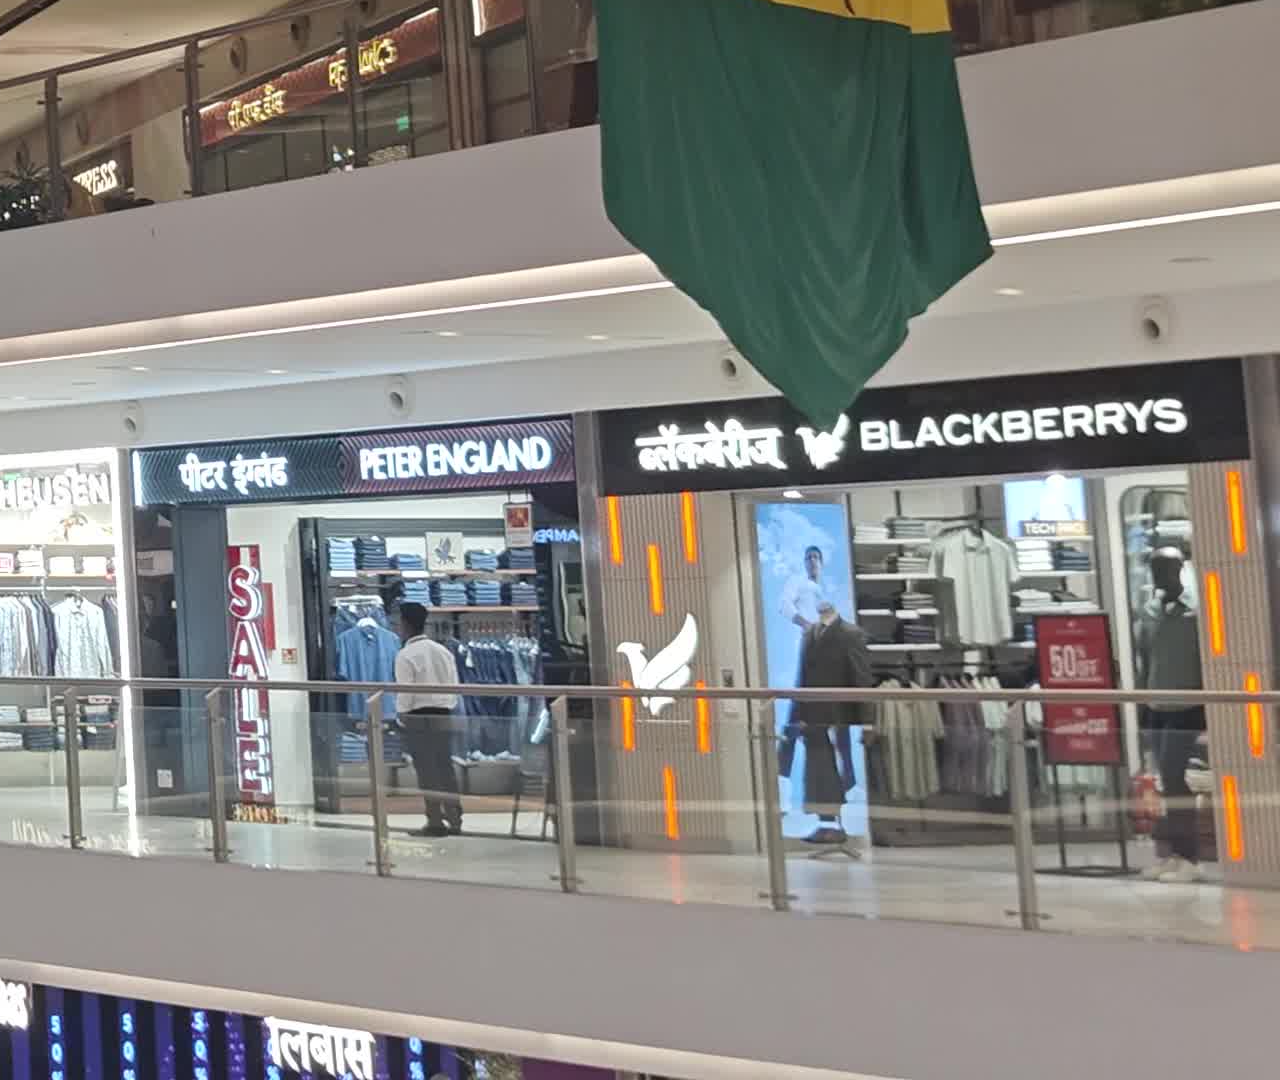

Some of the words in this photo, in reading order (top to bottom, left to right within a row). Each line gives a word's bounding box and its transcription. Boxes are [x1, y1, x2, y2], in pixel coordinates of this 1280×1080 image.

[859, 398, 1188, 451] BLACKBERRYS
[178, 453, 228, 492] पीटर
[359, 445, 424, 480] PETER
[426, 436, 552, 477] ENGLAND
[1024, 521, 1055, 534] TECH
[228, 564, 272, 796] SALE
